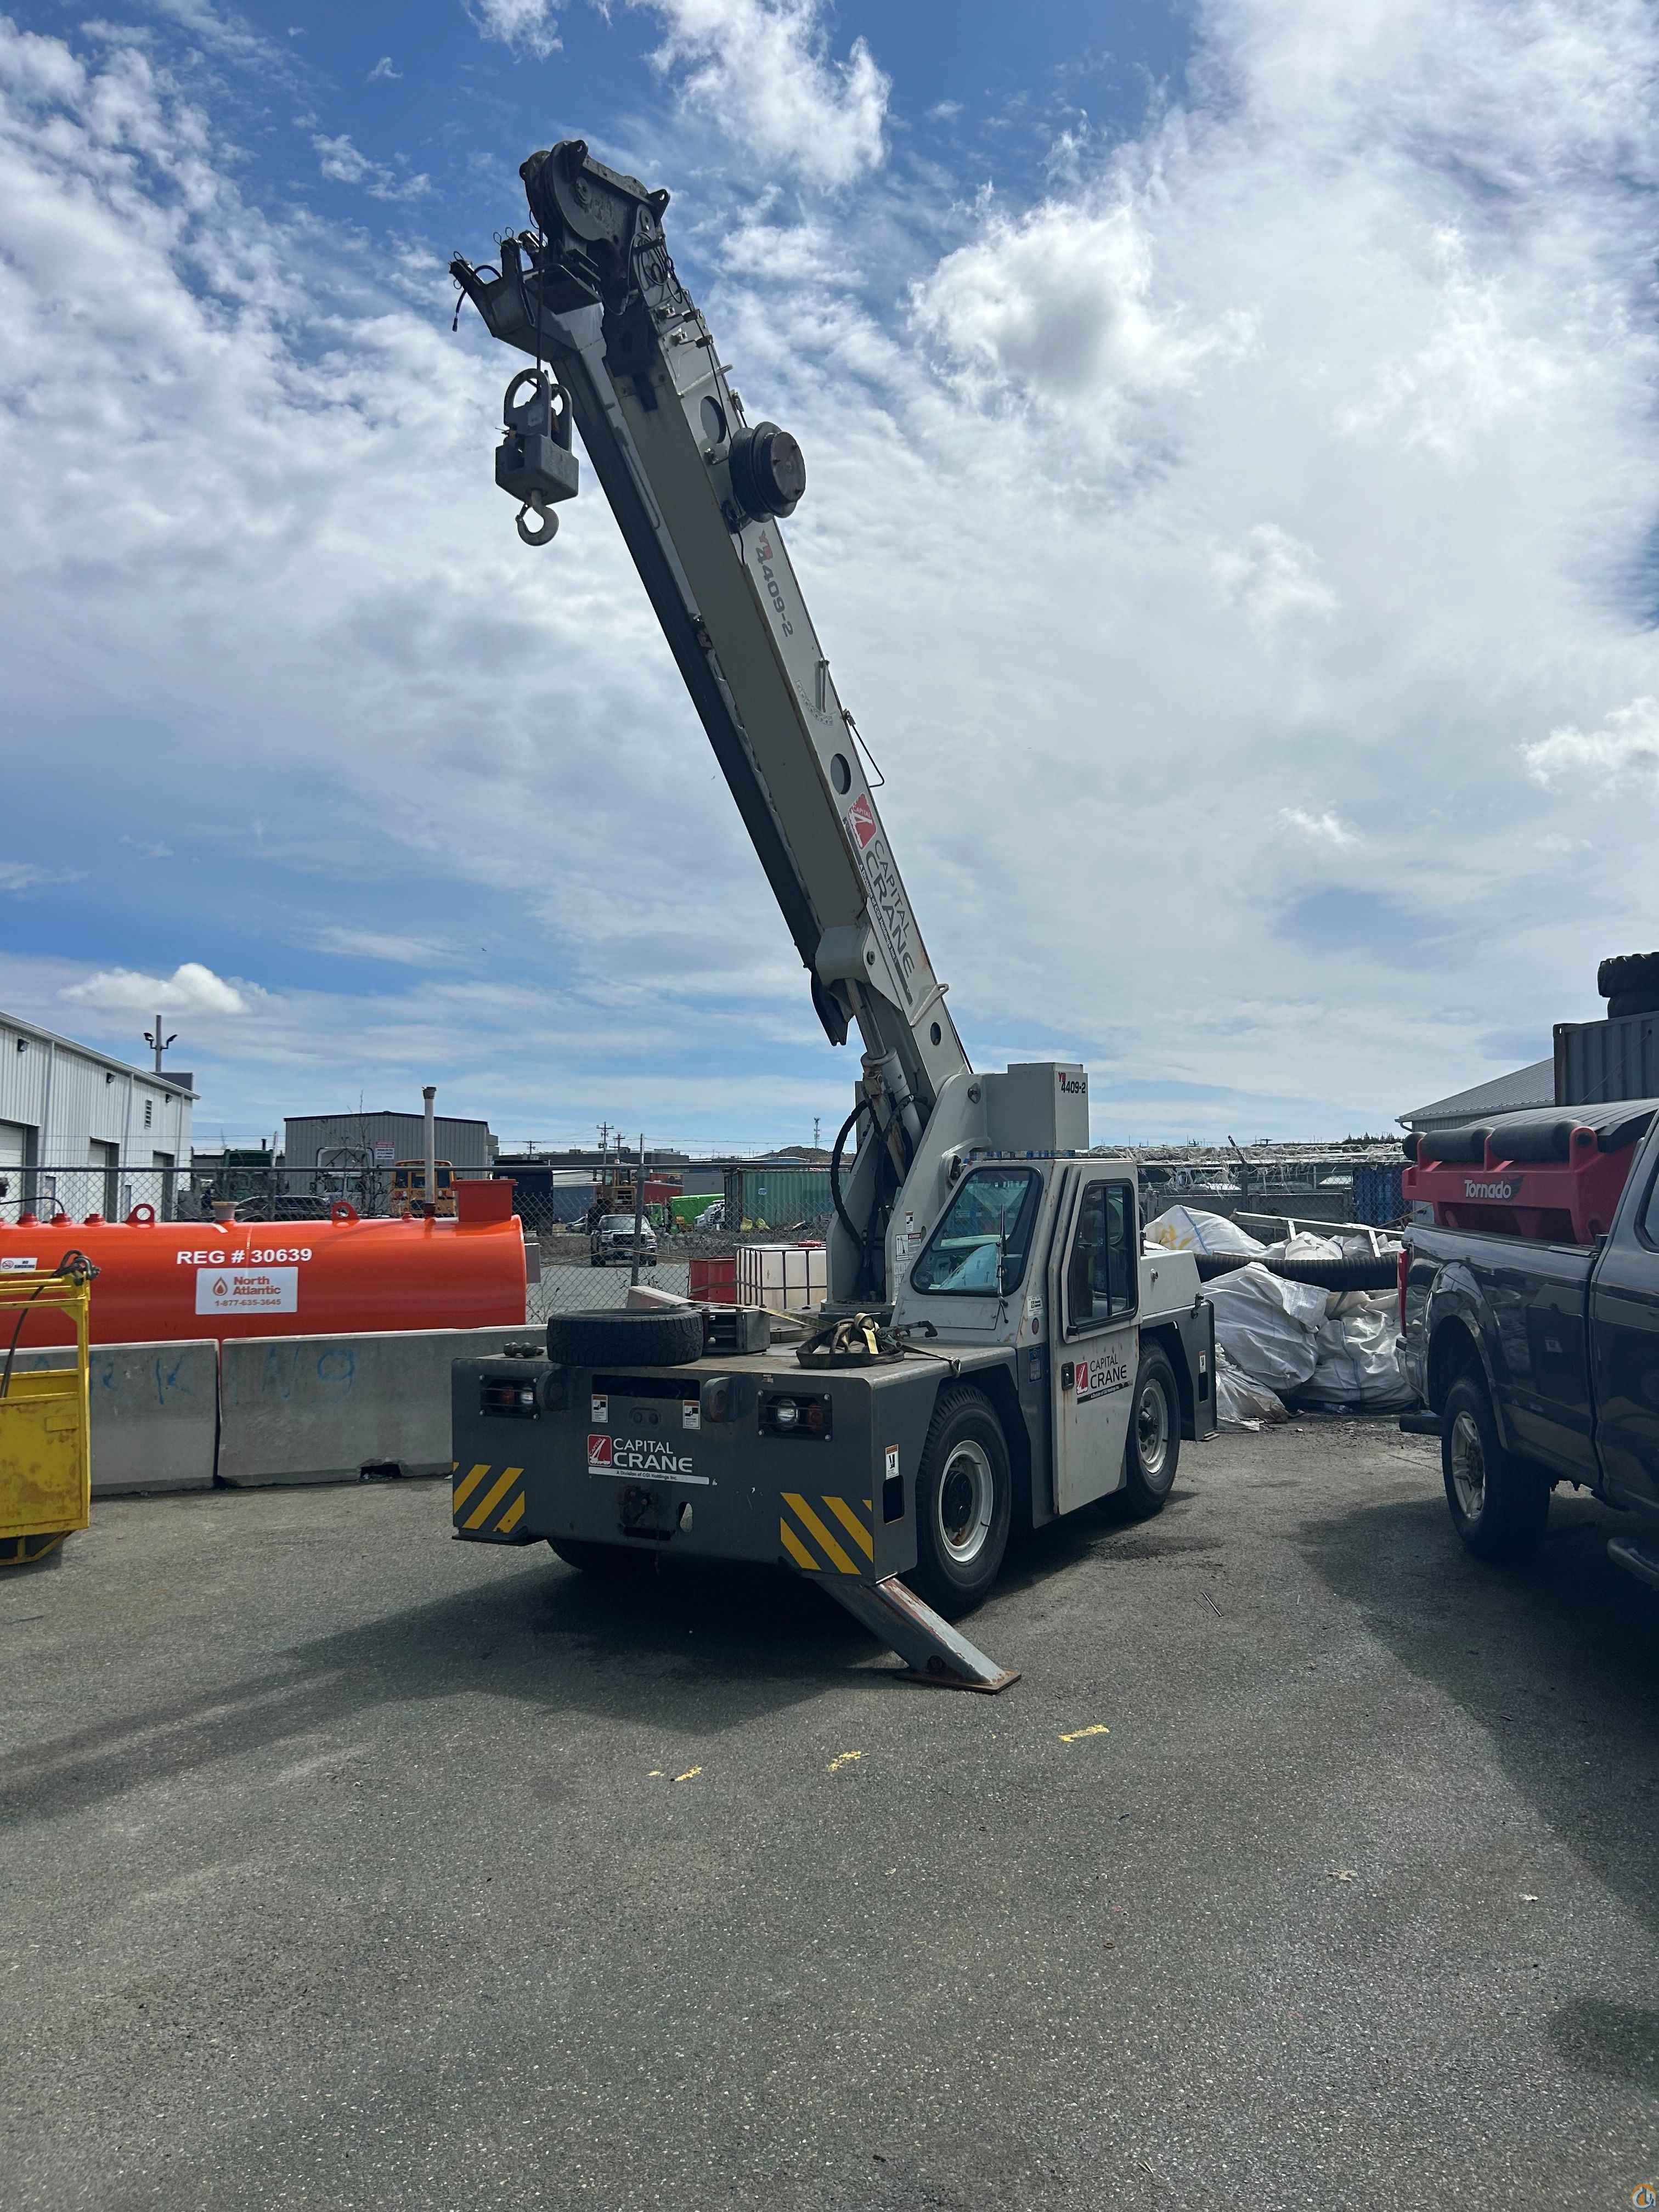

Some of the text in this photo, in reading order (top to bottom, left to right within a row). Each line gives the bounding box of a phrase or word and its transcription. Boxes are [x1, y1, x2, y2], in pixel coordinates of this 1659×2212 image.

[755, 548, 794, 637] 4409-2
[853, 804, 872, 817] CAPITAL
[875, 840, 909, 938] CAPITAL
[866, 851, 915, 978] CRANE
[1061, 1081, 1086, 1093] 4409-2
[1464, 1180, 1511, 1199] Tornado
[177, 1248, 312, 1264] REG # 30639
[233, 1285, 281, 1295] Atlantic
[234, 1276, 270, 1285] North
[1090, 1353, 1118, 1372] CAPITAL
[1090, 1364, 1126, 1389] CRANE
[613, 1438, 674, 1454] CAPITAL
[613, 1452, 692, 1473] CRANE
